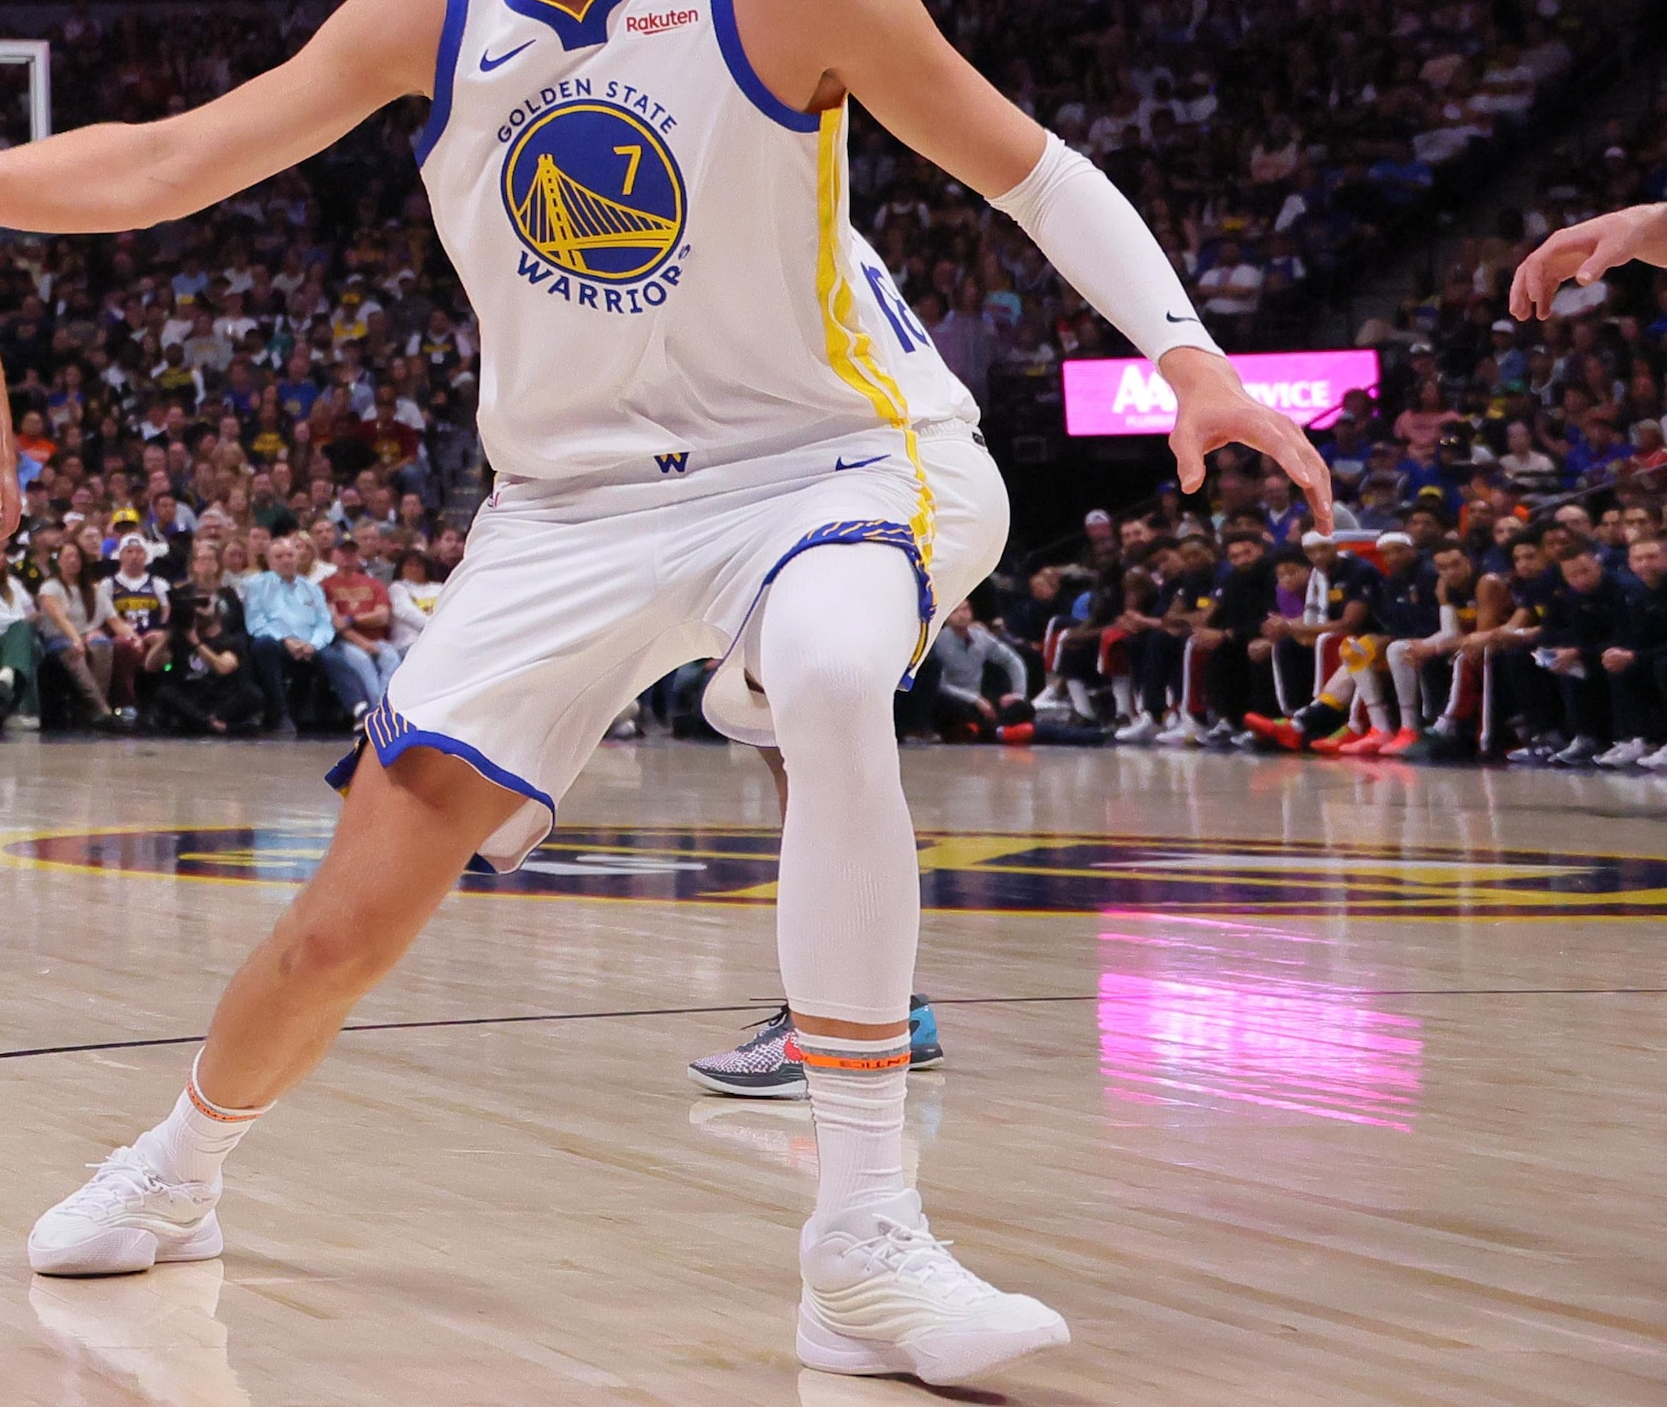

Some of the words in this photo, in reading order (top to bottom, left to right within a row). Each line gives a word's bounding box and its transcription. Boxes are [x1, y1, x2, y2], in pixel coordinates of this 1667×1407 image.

[625, 8, 699, 34] Rakuten
[497, 78, 592, 144] GOLDEN
[605, 80, 678, 135] STATE
[612, 144, 643, 196] 7
[1111, 364, 1178, 415] AA
